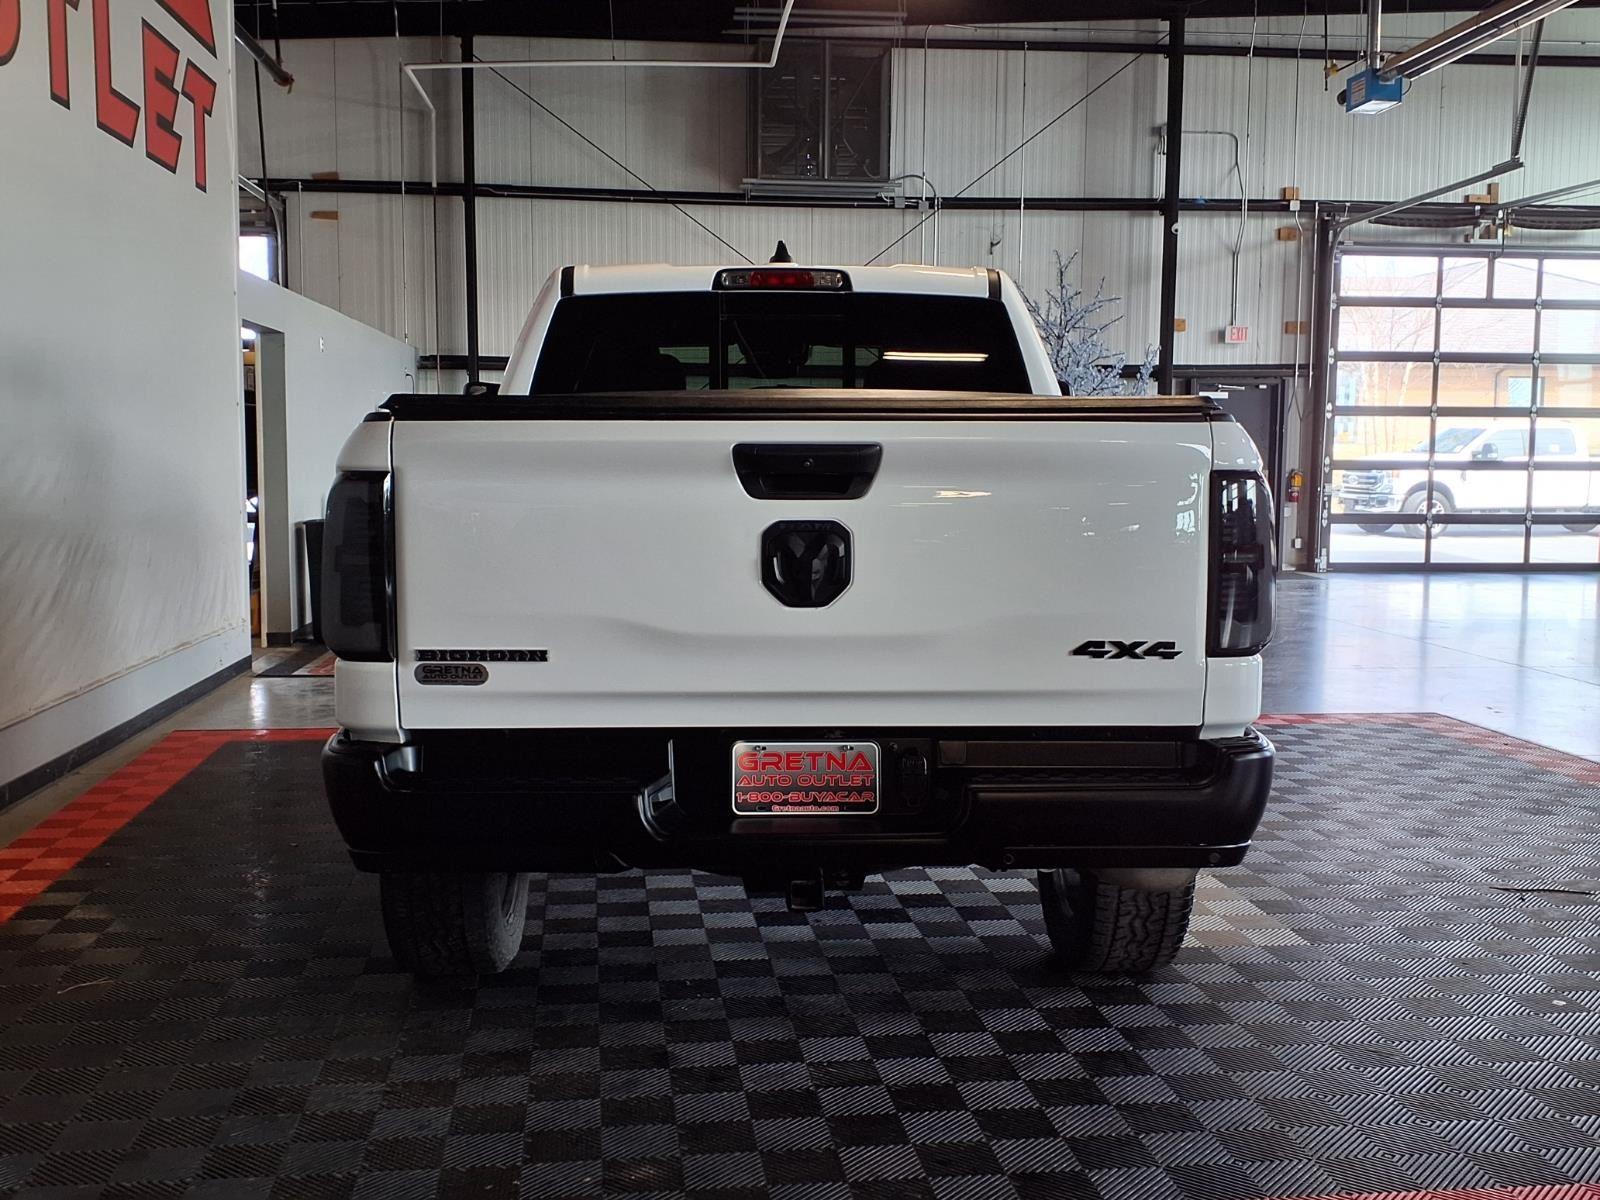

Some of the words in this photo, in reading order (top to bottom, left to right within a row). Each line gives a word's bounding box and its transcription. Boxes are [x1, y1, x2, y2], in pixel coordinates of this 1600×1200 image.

[1231, 326, 1248, 341] EXIT
[422, 665, 483, 674] GRETNA
[737, 751, 874, 772] GRETNA
[736, 774, 792, 787] AUTO
[797, 774, 875, 787] OUTLET
[736, 791, 875, 803] 1-800-BUYACAR
